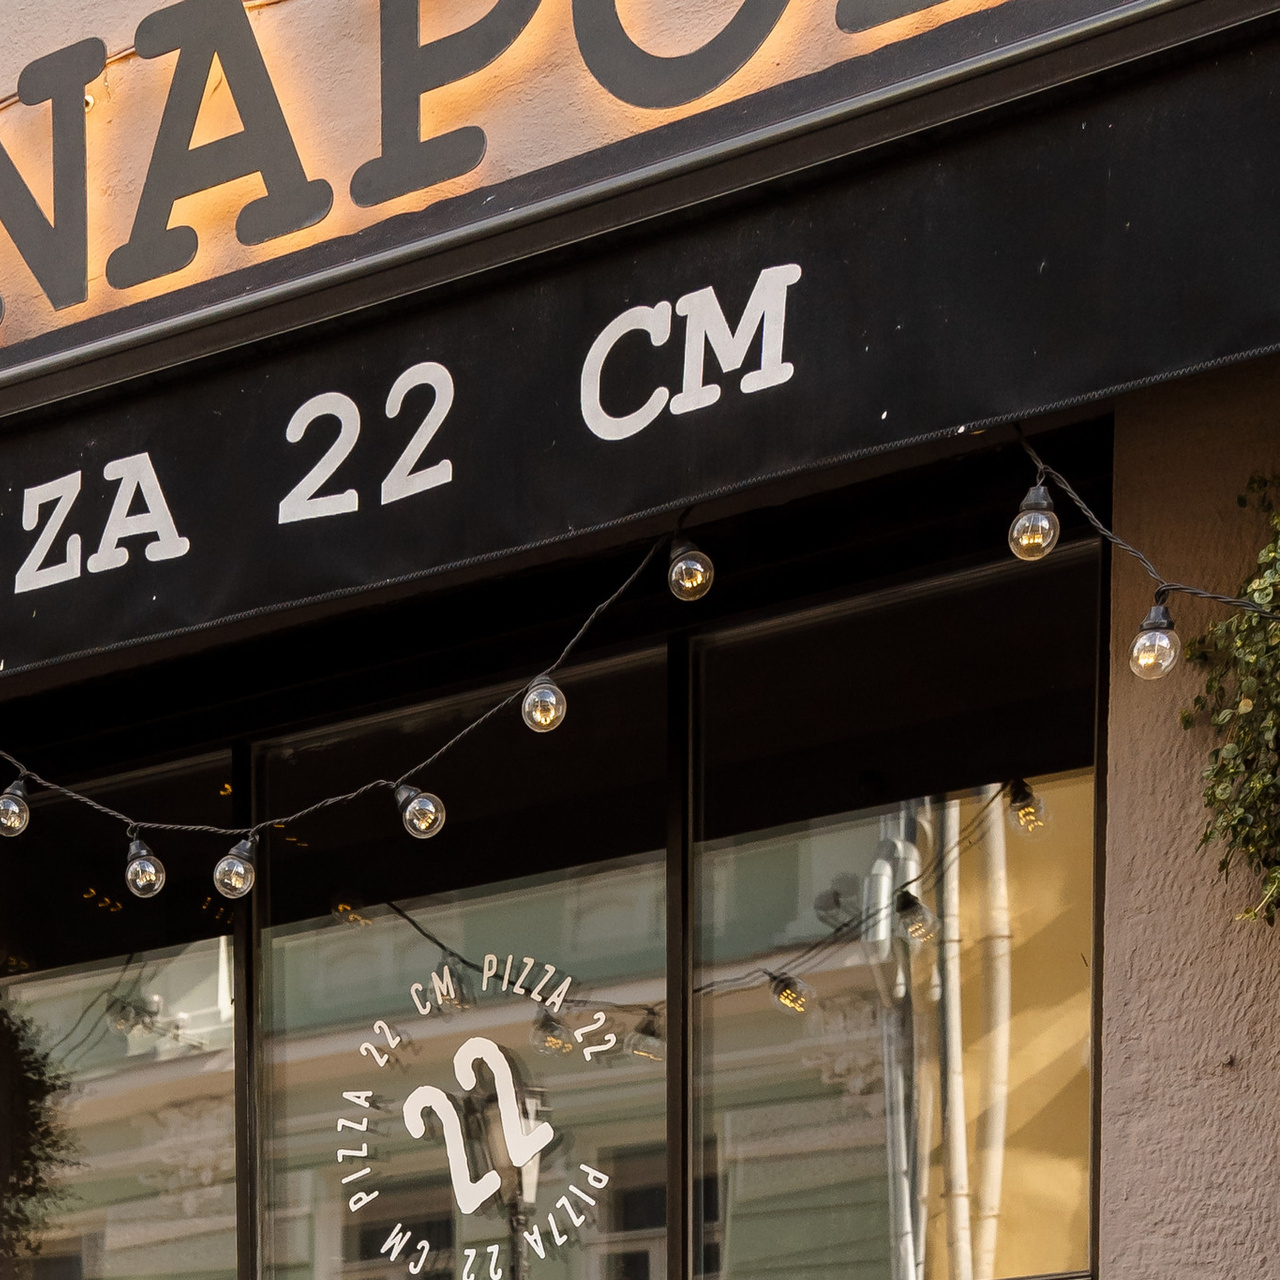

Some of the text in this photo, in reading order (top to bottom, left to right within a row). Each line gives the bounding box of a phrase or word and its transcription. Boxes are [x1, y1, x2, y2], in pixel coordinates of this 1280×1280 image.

[278, 361, 456, 526] 22
[580, 263, 802, 441] CM
[337, 965, 456, 1213] PIZZA 22 CM
[482, 953, 617, 1061] PIZZA 22
[402, 1036, 555, 1215] 22
[380, 1222, 431, 1275] CM
